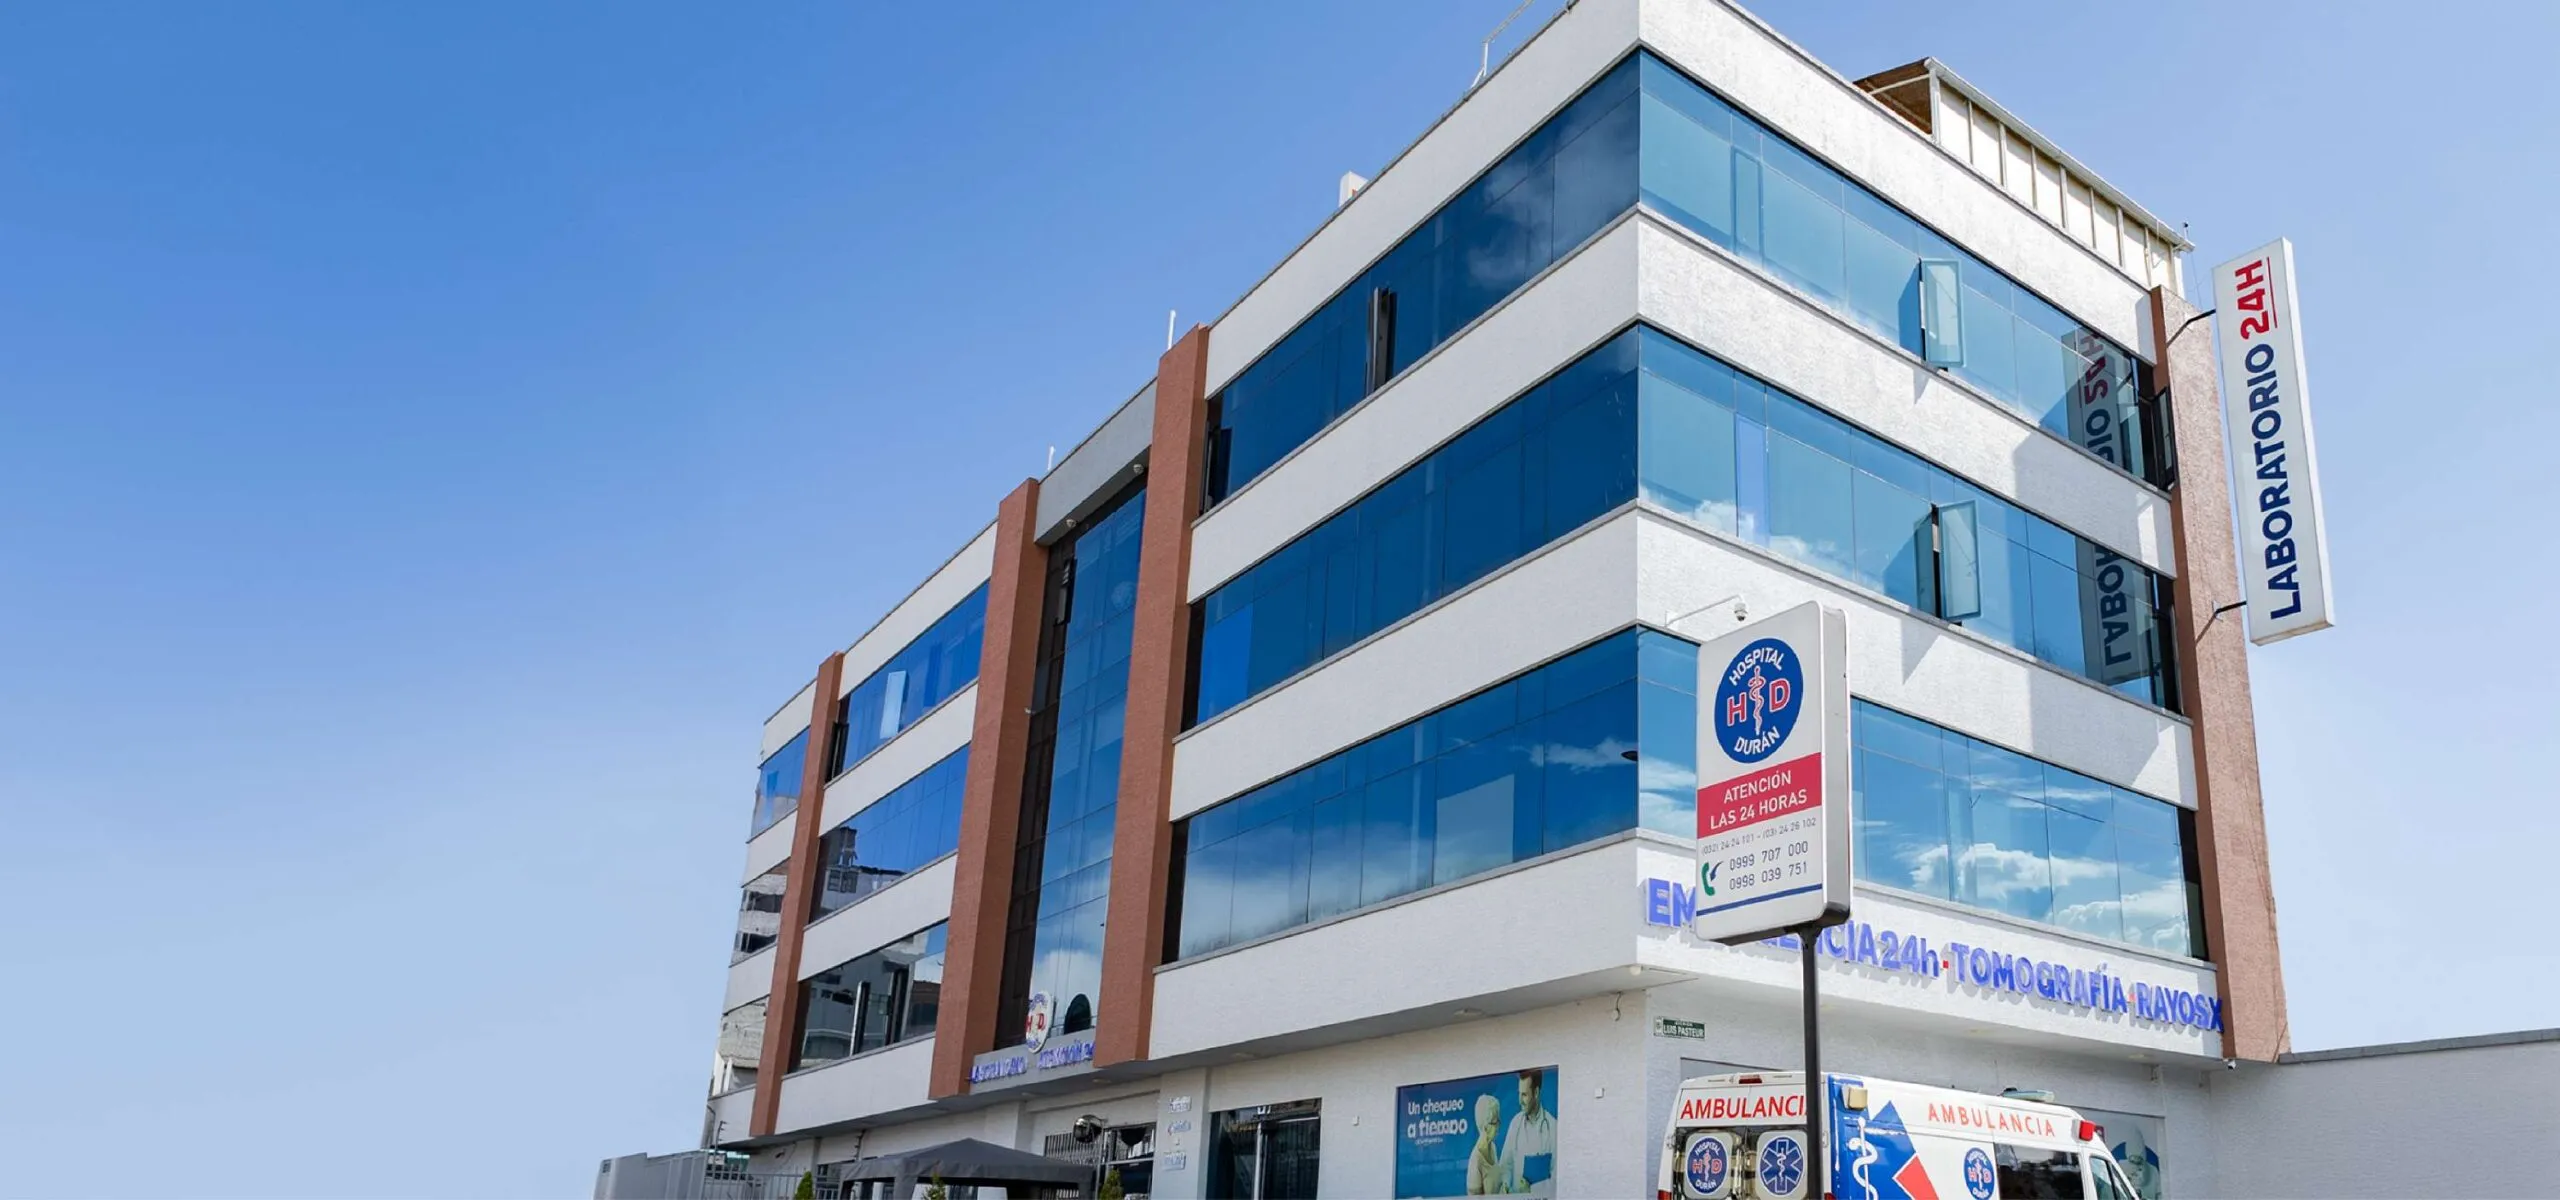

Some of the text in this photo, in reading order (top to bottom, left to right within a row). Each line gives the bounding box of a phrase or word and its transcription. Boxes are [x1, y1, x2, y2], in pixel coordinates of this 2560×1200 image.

[2235, 259, 2302, 620] LABORATORIO 24H
[1729, 647, 1784, 686] HOSPITAL
[1734, 726, 1780, 755] DURÁN
[1724, 770, 1791, 804] ATENCIÓN
[1710, 789, 1807, 829] LAS 24 HORAS
[1729, 841, 1808, 871] 0999 707 000
[1729, 861, 1807, 890] 0998 039 751
[1408, 1098, 1464, 1117] Un chequeo
[1680, 1095, 1807, 1119] AMBULANCI
[1928, 1103, 2056, 1137] AMBULANCIA
[1407, 1116, 1468, 1138] a tiempo
